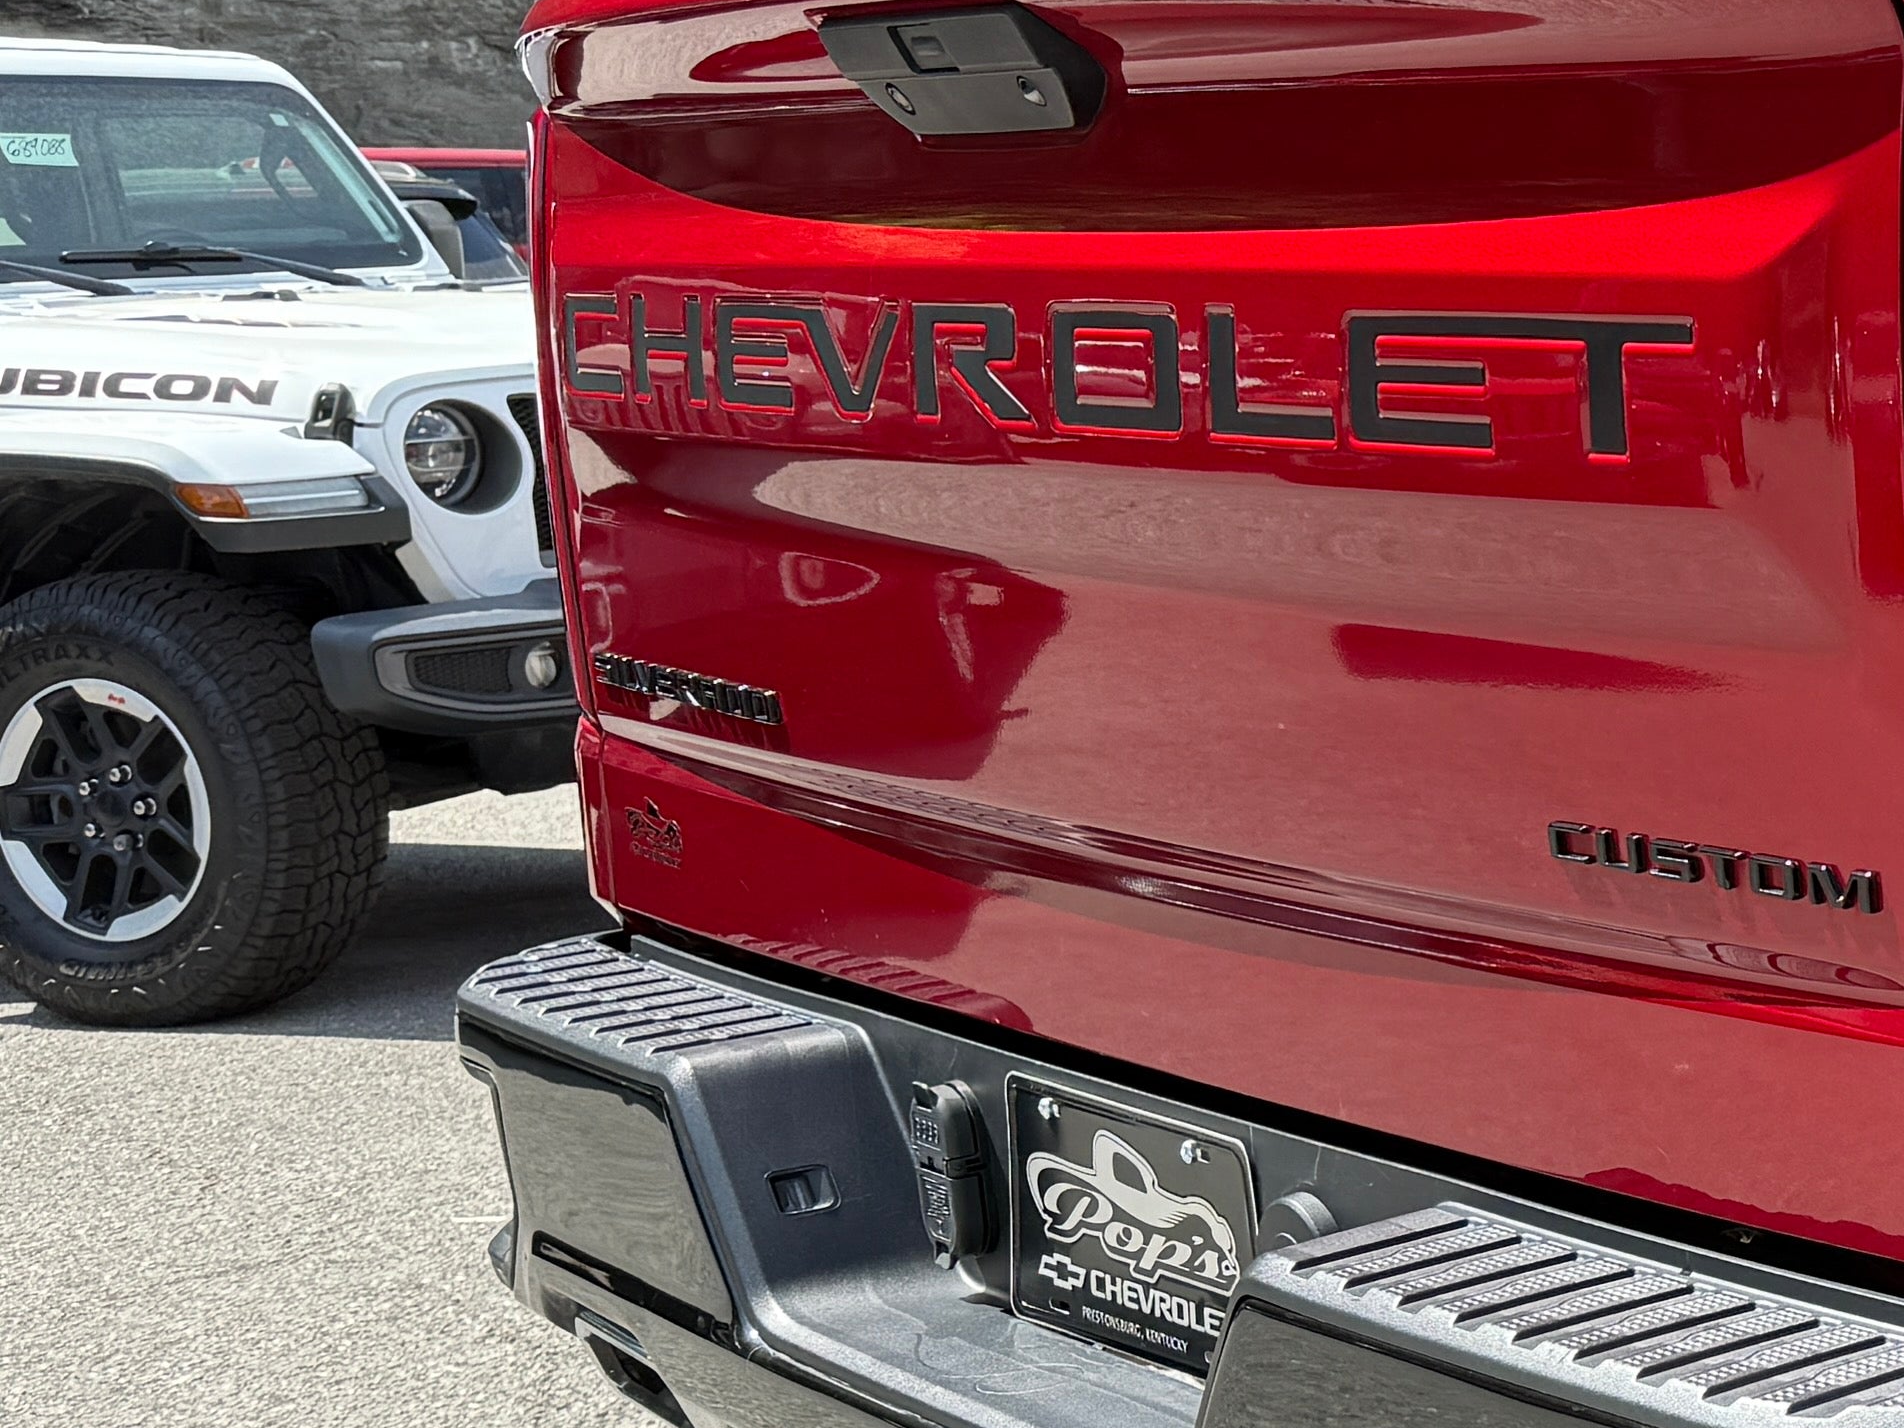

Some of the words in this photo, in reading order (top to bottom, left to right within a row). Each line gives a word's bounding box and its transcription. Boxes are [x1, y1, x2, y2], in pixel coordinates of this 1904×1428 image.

[560, 291, 1696, 465] CHEVROLET
[594, 652, 783, 726] SILVERADO
[1547, 820, 1884, 915] CUSTOM
[1044, 1182, 1228, 1283] Pop's
[1090, 1269, 1226, 1337] CHEVROLE
[1145, 1327, 1189, 1354] KENTUCKY
